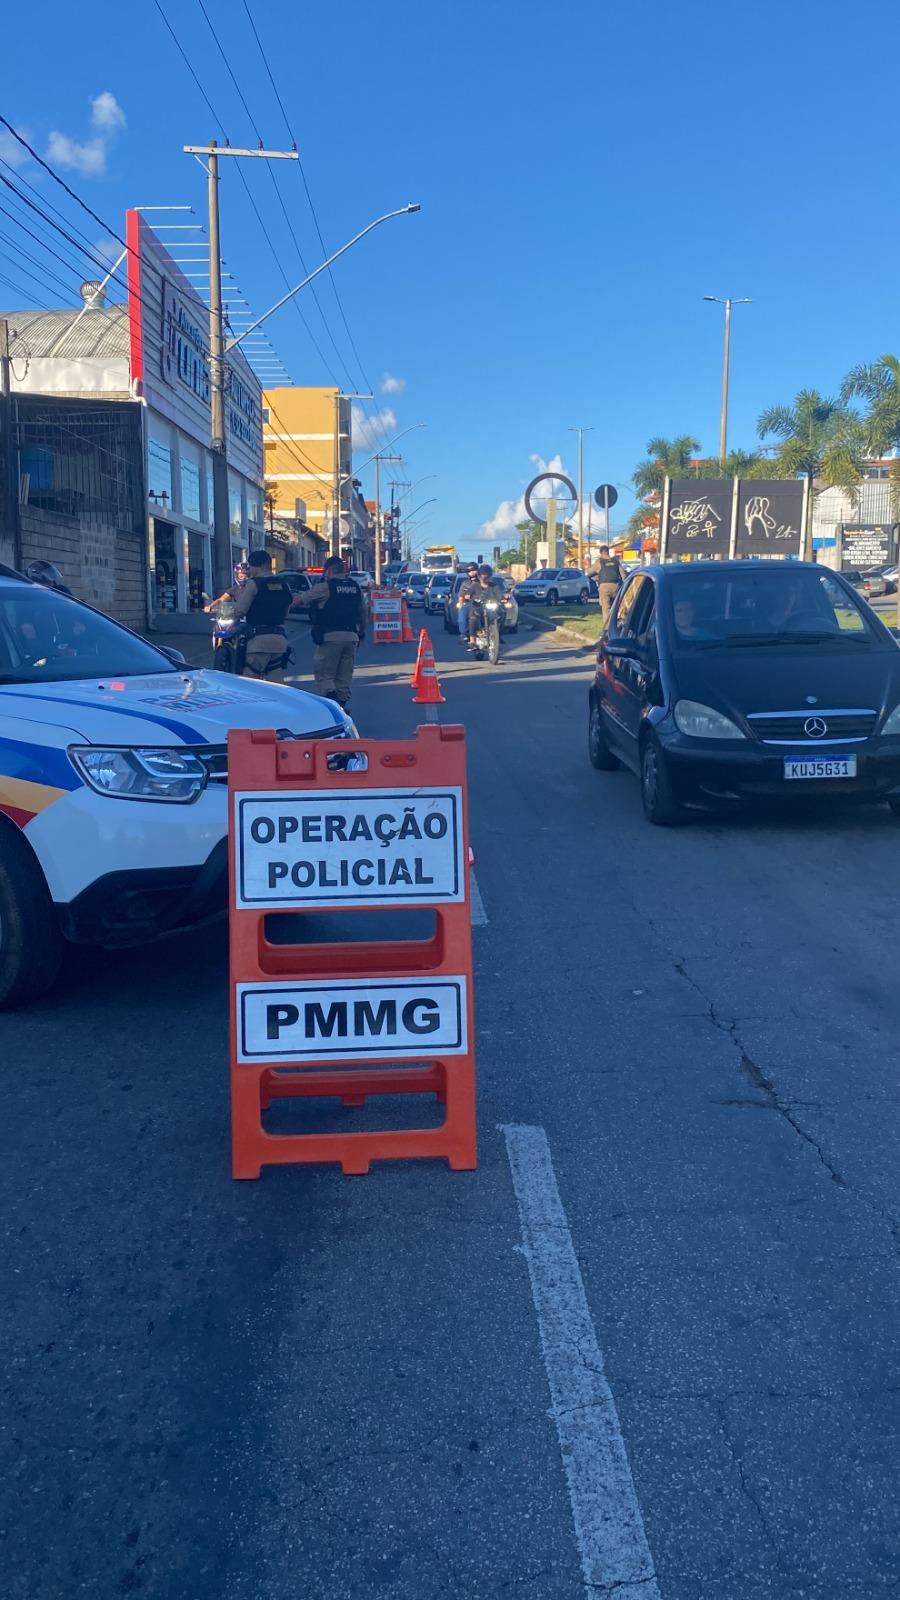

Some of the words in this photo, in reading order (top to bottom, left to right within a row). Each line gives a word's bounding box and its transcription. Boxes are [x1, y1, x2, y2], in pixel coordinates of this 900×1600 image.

[377, 622, 399, 630] PMMG
[791, 762, 849, 777] KUJ5G31
[250, 807, 448, 848] OPERAÇÃO
[268, 857, 434, 889] POLICIAL
[266, 998, 440, 1040] PMMG
